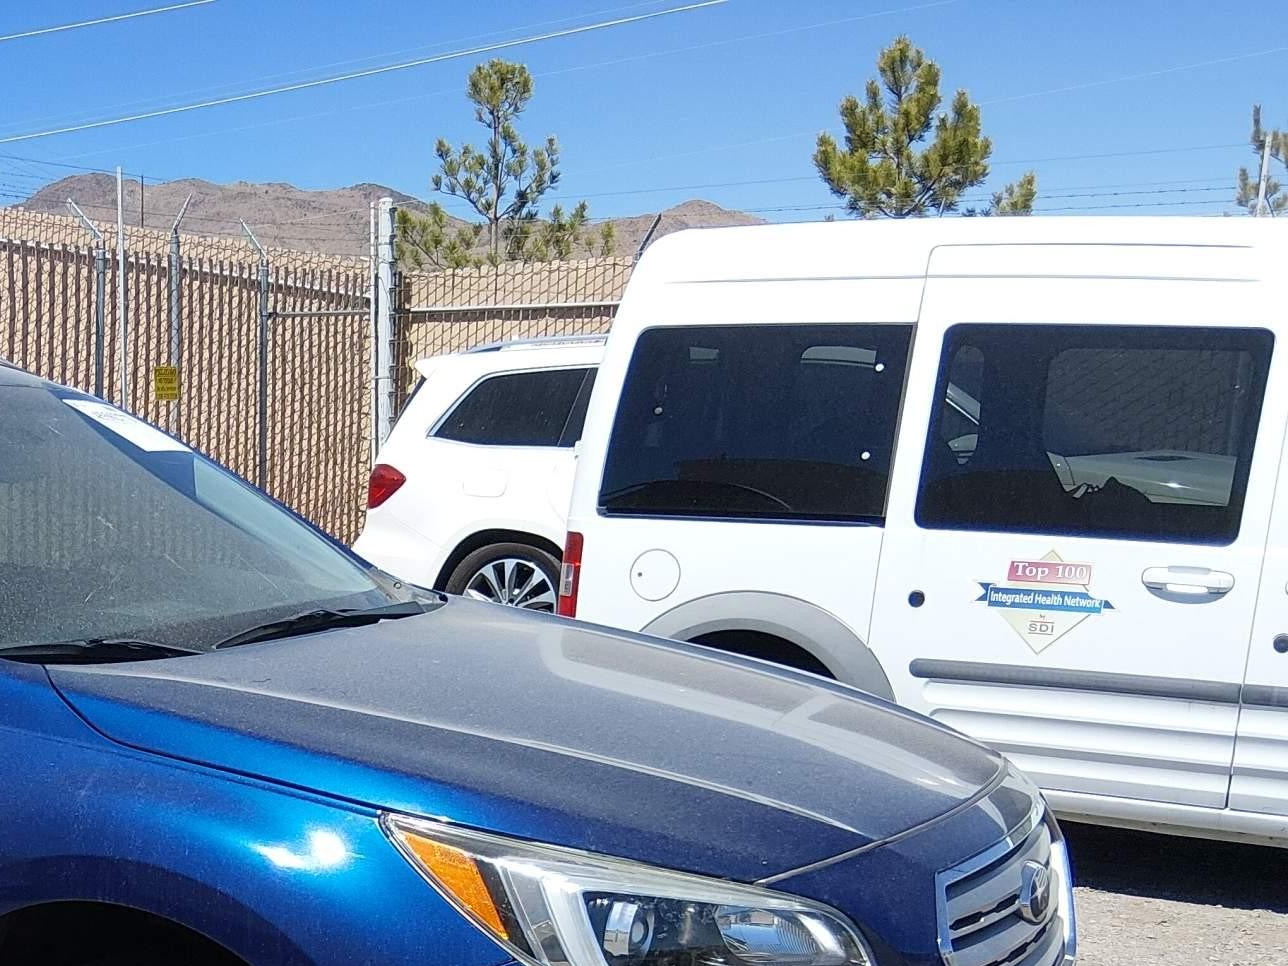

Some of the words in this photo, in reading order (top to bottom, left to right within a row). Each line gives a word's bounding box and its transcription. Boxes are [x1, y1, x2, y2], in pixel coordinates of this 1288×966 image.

[1013, 562, 1049, 580] Top
[1055, 565, 1087, 580] 100
[990, 590, 1033, 606] Integrated
[1035, 594, 1062, 606] Health
[1064, 597, 1101, 608] Network
[1028, 623, 1055, 633] SDI
